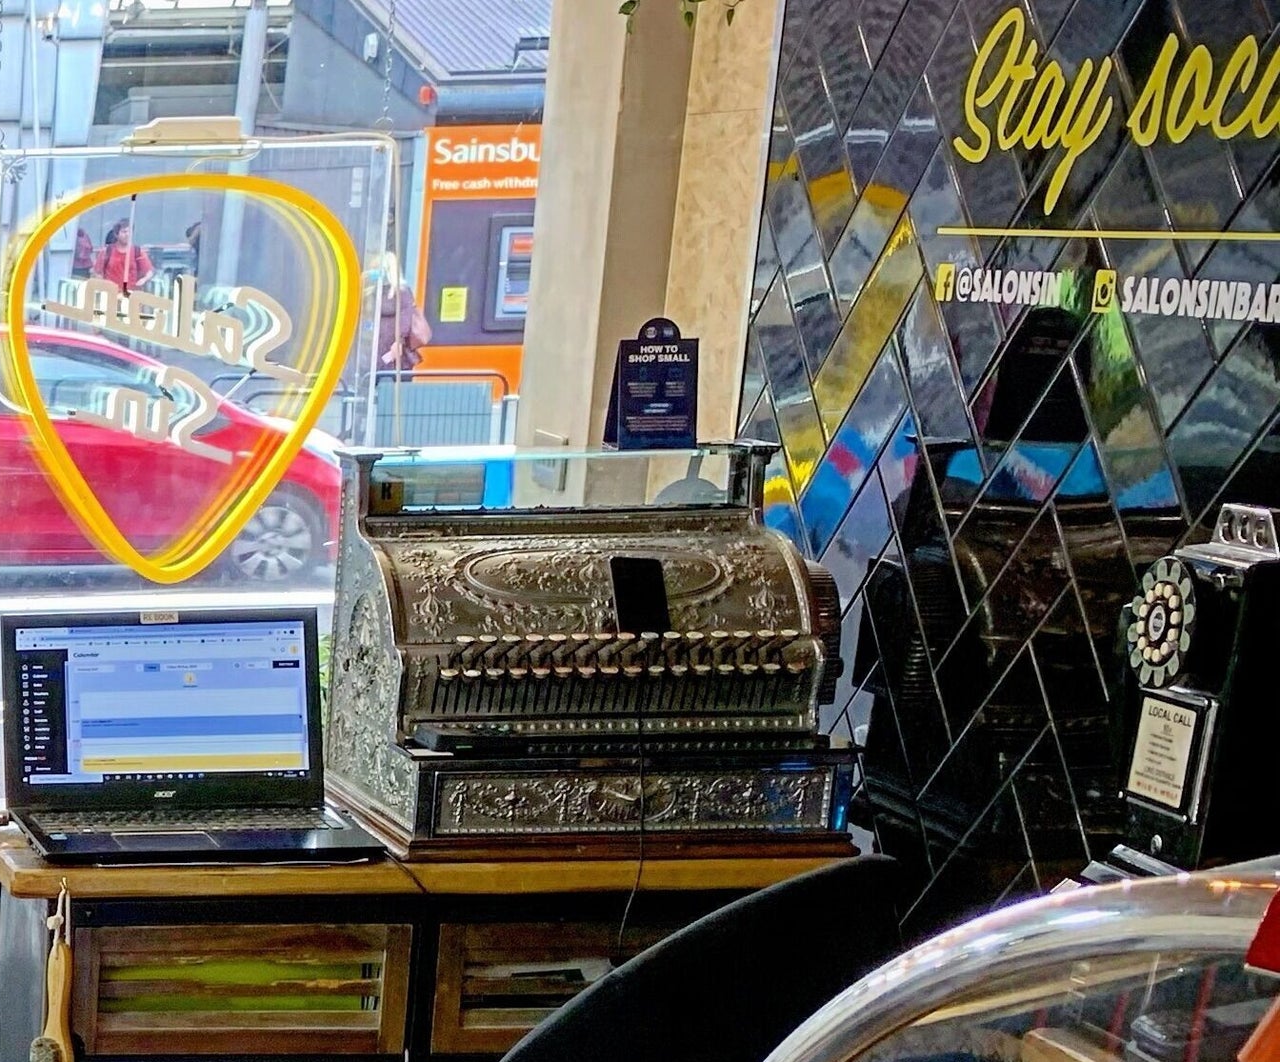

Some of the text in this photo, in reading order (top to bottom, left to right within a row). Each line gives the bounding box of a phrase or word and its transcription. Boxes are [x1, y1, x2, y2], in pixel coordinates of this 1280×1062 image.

[953, 7, 1114, 216] Stay
[432, 178, 459, 190] Free
[462, 178, 491, 190] cash
[640, 345, 678, 353] HOW TO
[628, 353, 690, 363] SHOP SMALL
[1148, 706, 1191, 727] LOCAL CALL
[154, 790, 176, 798] acer
